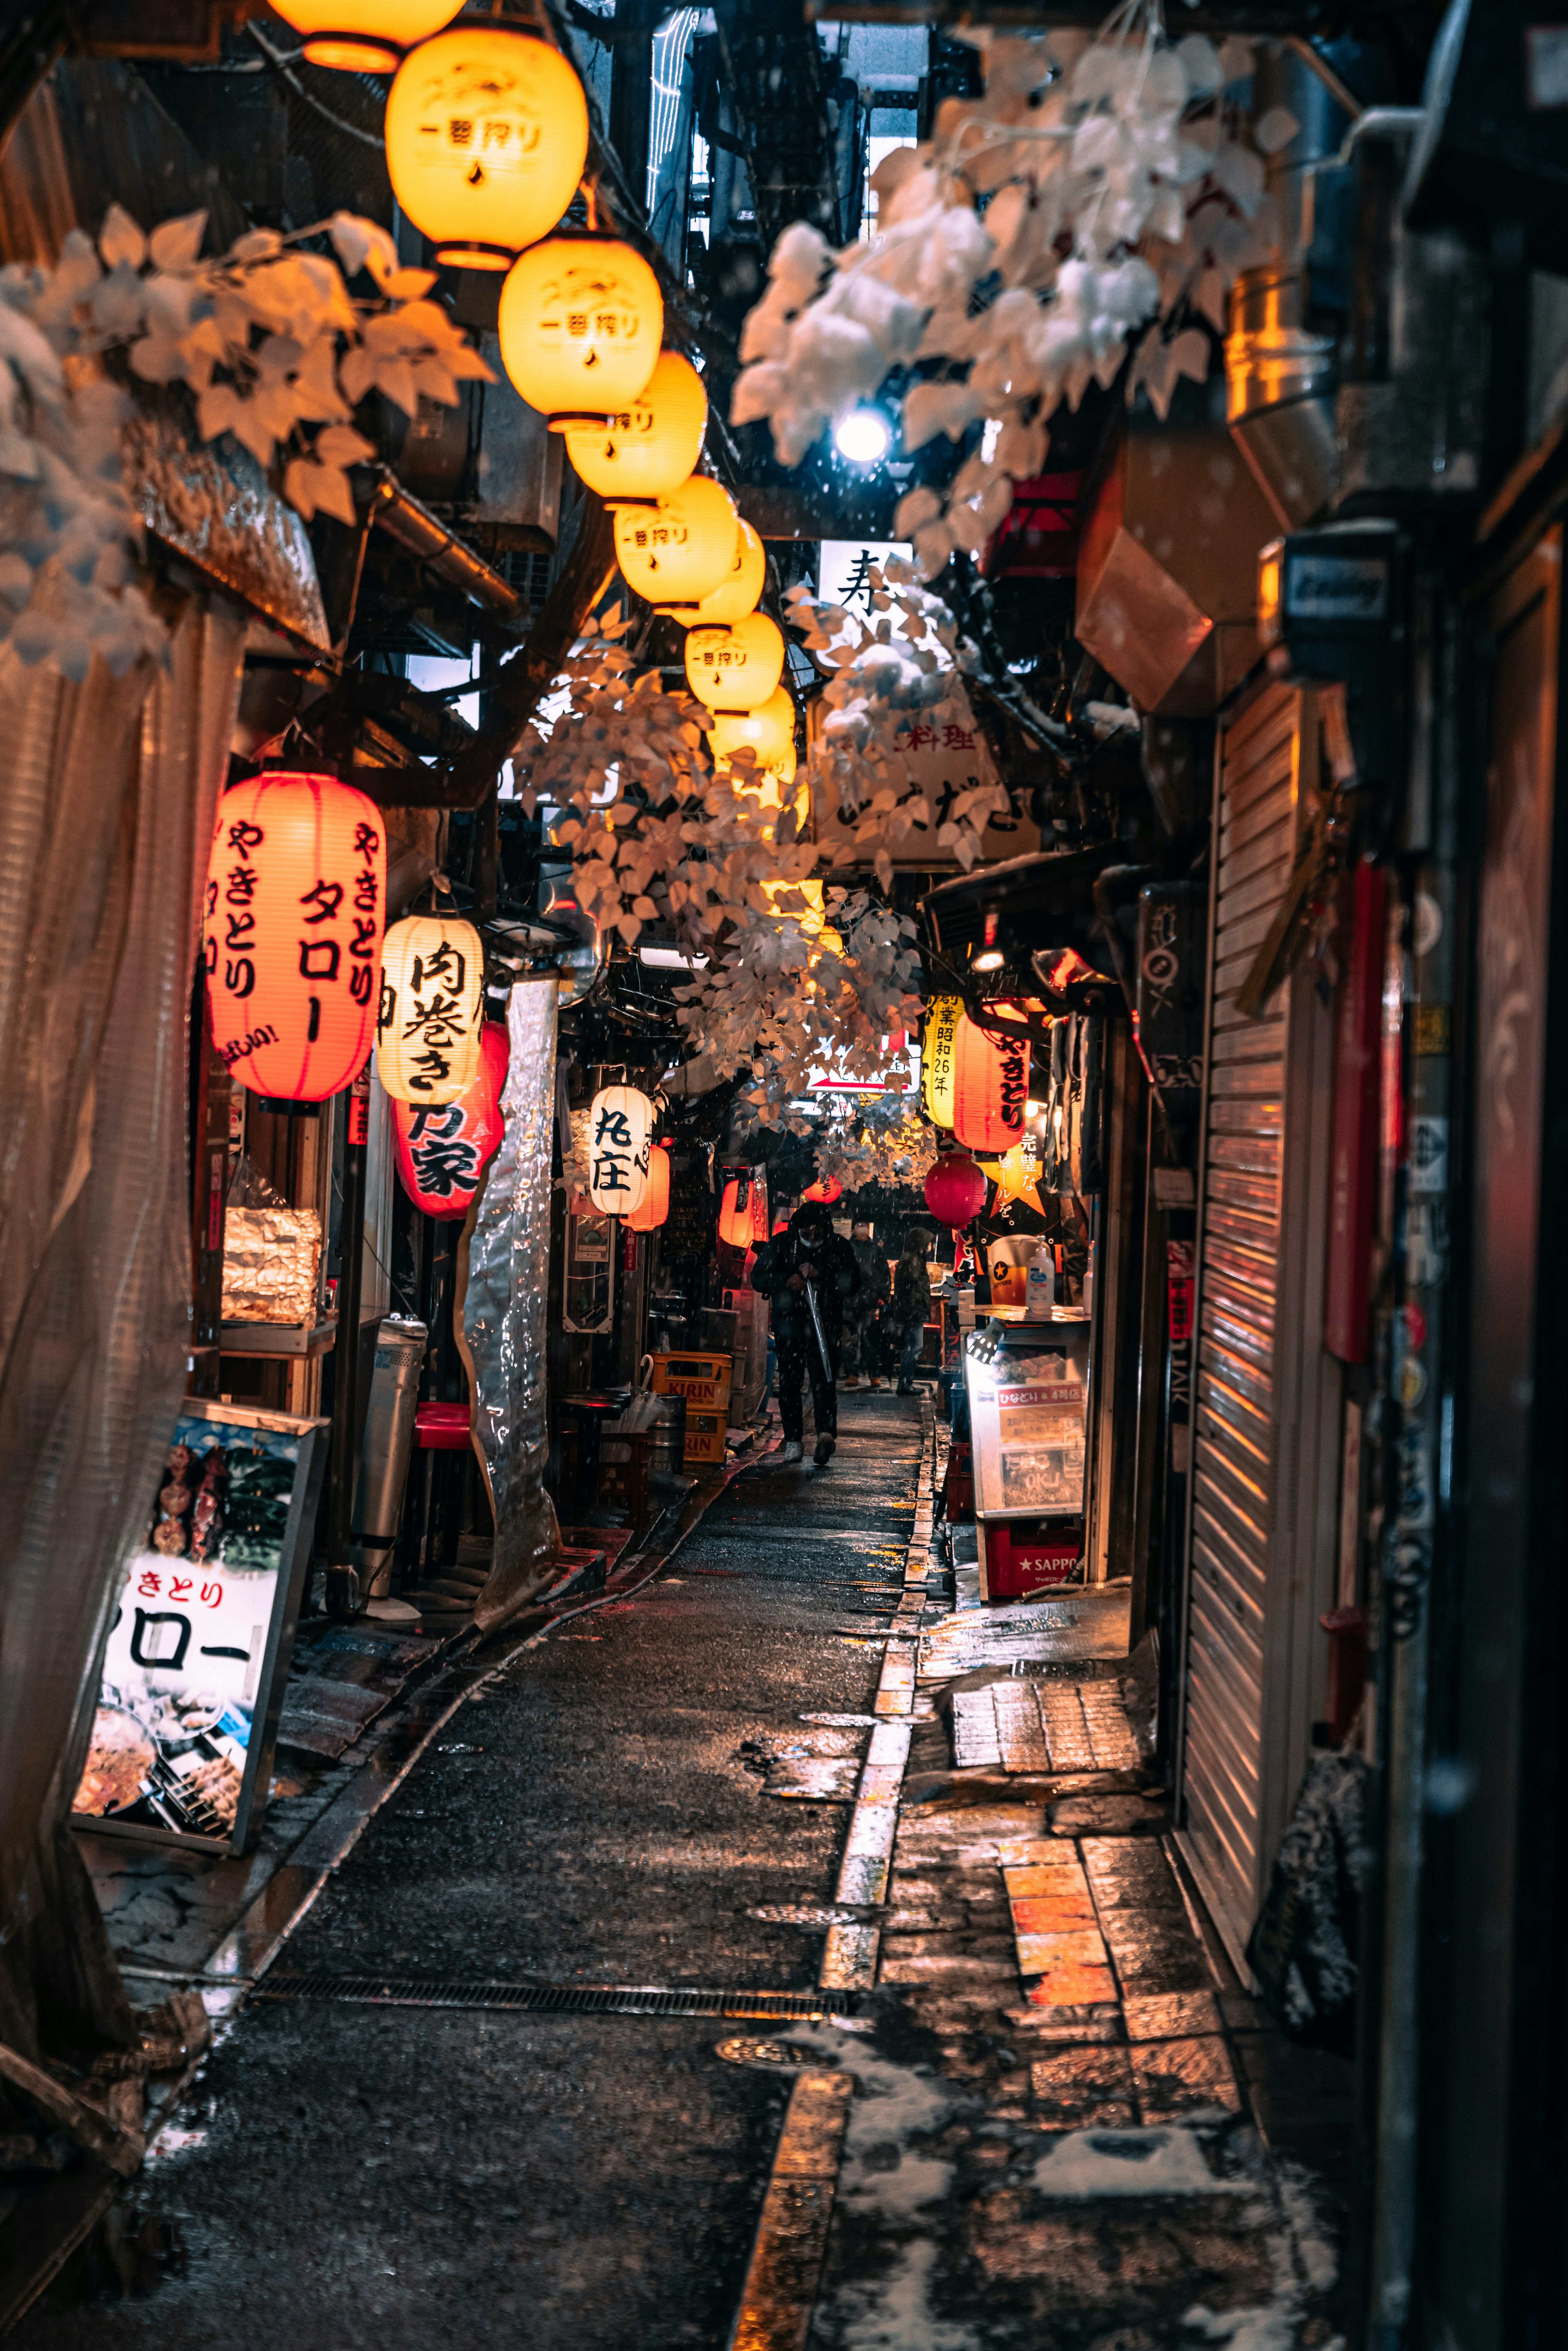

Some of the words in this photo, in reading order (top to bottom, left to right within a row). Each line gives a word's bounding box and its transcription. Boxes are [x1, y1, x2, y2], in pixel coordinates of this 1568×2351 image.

[541, 314, 639, 338] 一番搾り
[624, 528, 688, 546] 一番搾り
[693, 653, 747, 667] 一番搾り
[225, 821, 264, 999] やきとり
[349, 822, 379, 1006] やきとり
[299, 879, 344, 1043] タロー
[402, 941, 467, 1090] 肉巻き
[934, 995, 958, 1096] 創業昭和26年
[996, 1036, 1025, 1130] やきとり
[593, 1107, 632, 1192] 丸庄
[1020, 1132, 1037, 1191] 完璧な
[998, 1149, 1015, 1226] ビールを。
[669, 1383, 715, 1398] KIRIN
[137, 1570, 224, 1609] きとり
[1035, 1558, 1077, 1571] SAPPO
[130, 1607, 251, 1671] ロー
